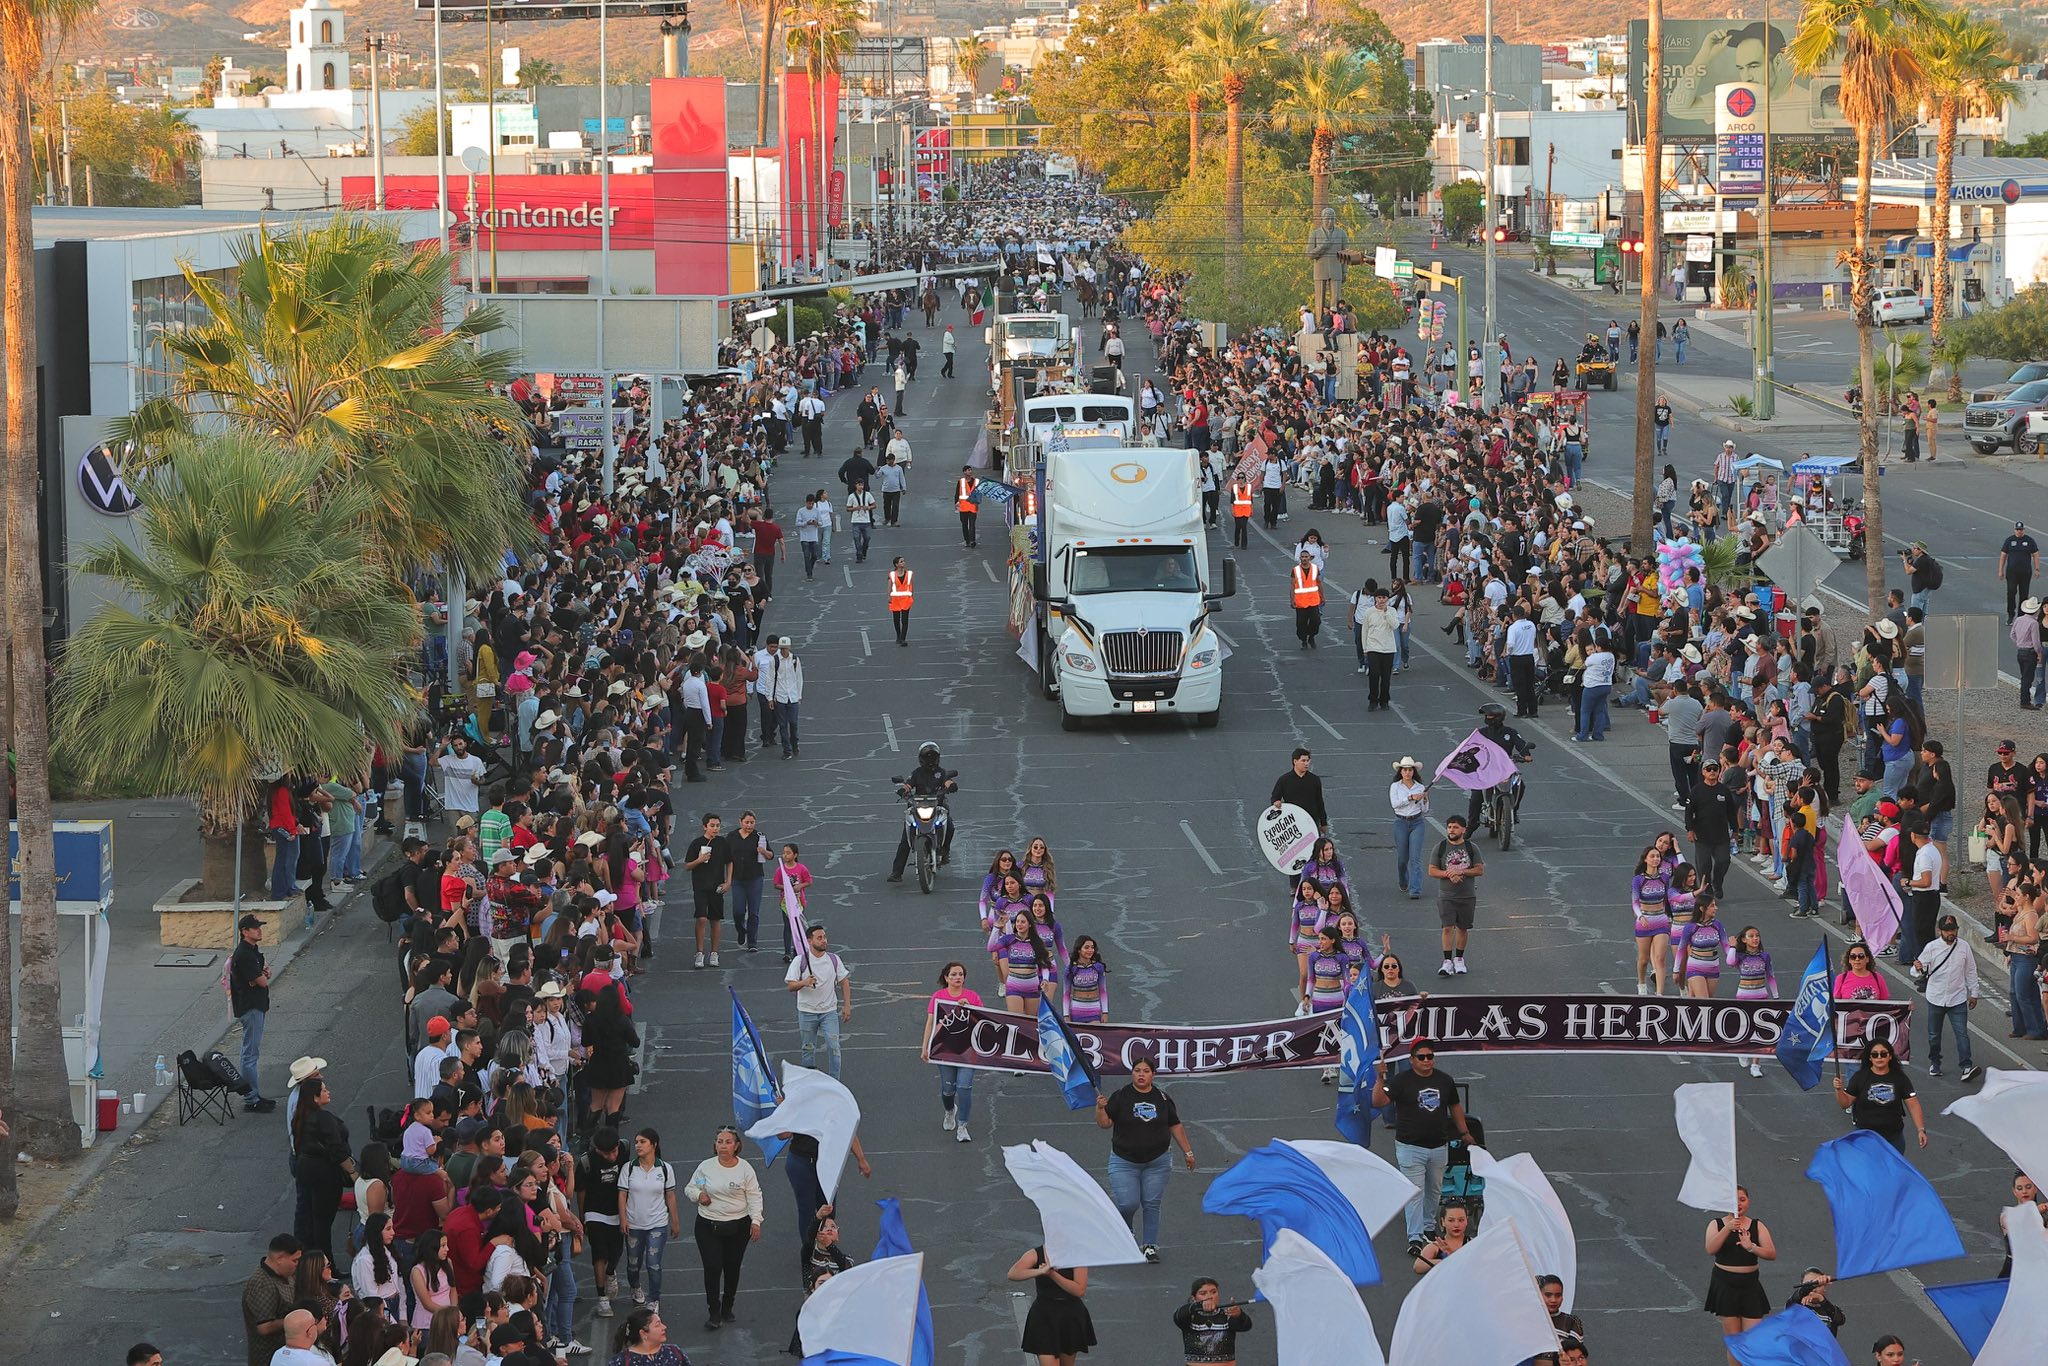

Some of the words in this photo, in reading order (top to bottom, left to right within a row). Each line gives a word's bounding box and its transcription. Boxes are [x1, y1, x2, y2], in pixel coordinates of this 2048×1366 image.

[1727, 123, 1756, 131] ARCO
[1738, 135, 1764, 145] 24.39
[1738, 147, 1764, 156] 29.99
[1955, 184, 1994, 200] ARCO
[463, 201, 620, 228] Santander
[1263, 813, 1296, 842] EXPOGAN
[1271, 824, 1303, 851] SONORA
[970, 1018, 1104, 1070] CLB
[1120, 1029, 1300, 1074] CHEER
[1563, 1003, 1900, 1048] HERMOSLO
